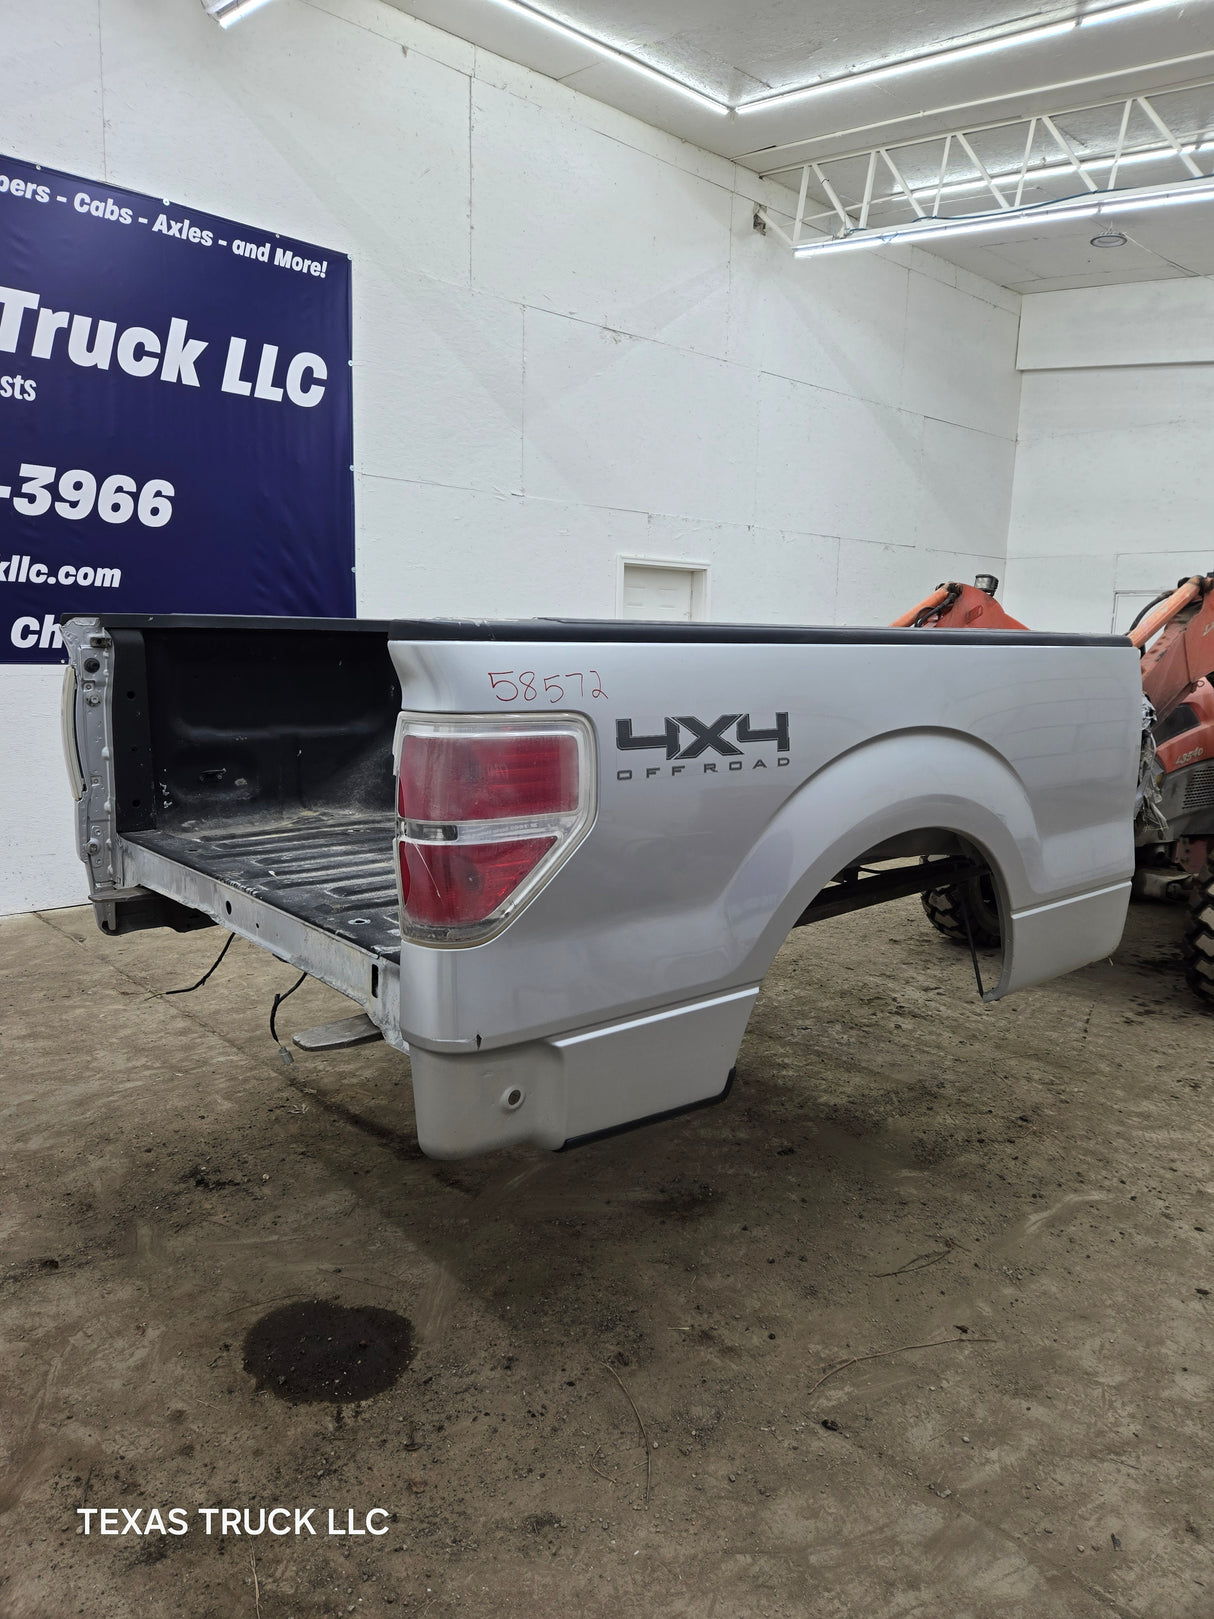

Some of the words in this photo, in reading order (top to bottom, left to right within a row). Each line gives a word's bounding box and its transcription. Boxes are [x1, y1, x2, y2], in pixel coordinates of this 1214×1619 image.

[73, 192, 133, 225] Cabs
[152, 214, 213, 247] Axles
[232, 239, 271, 263] and
[274, 248, 328, 279] More!
[0, 285, 209, 387] Truck
[221, 336, 328, 408] LLC
[487, 670, 609, 703] 58572
[615, 711, 790, 760] 4X4
